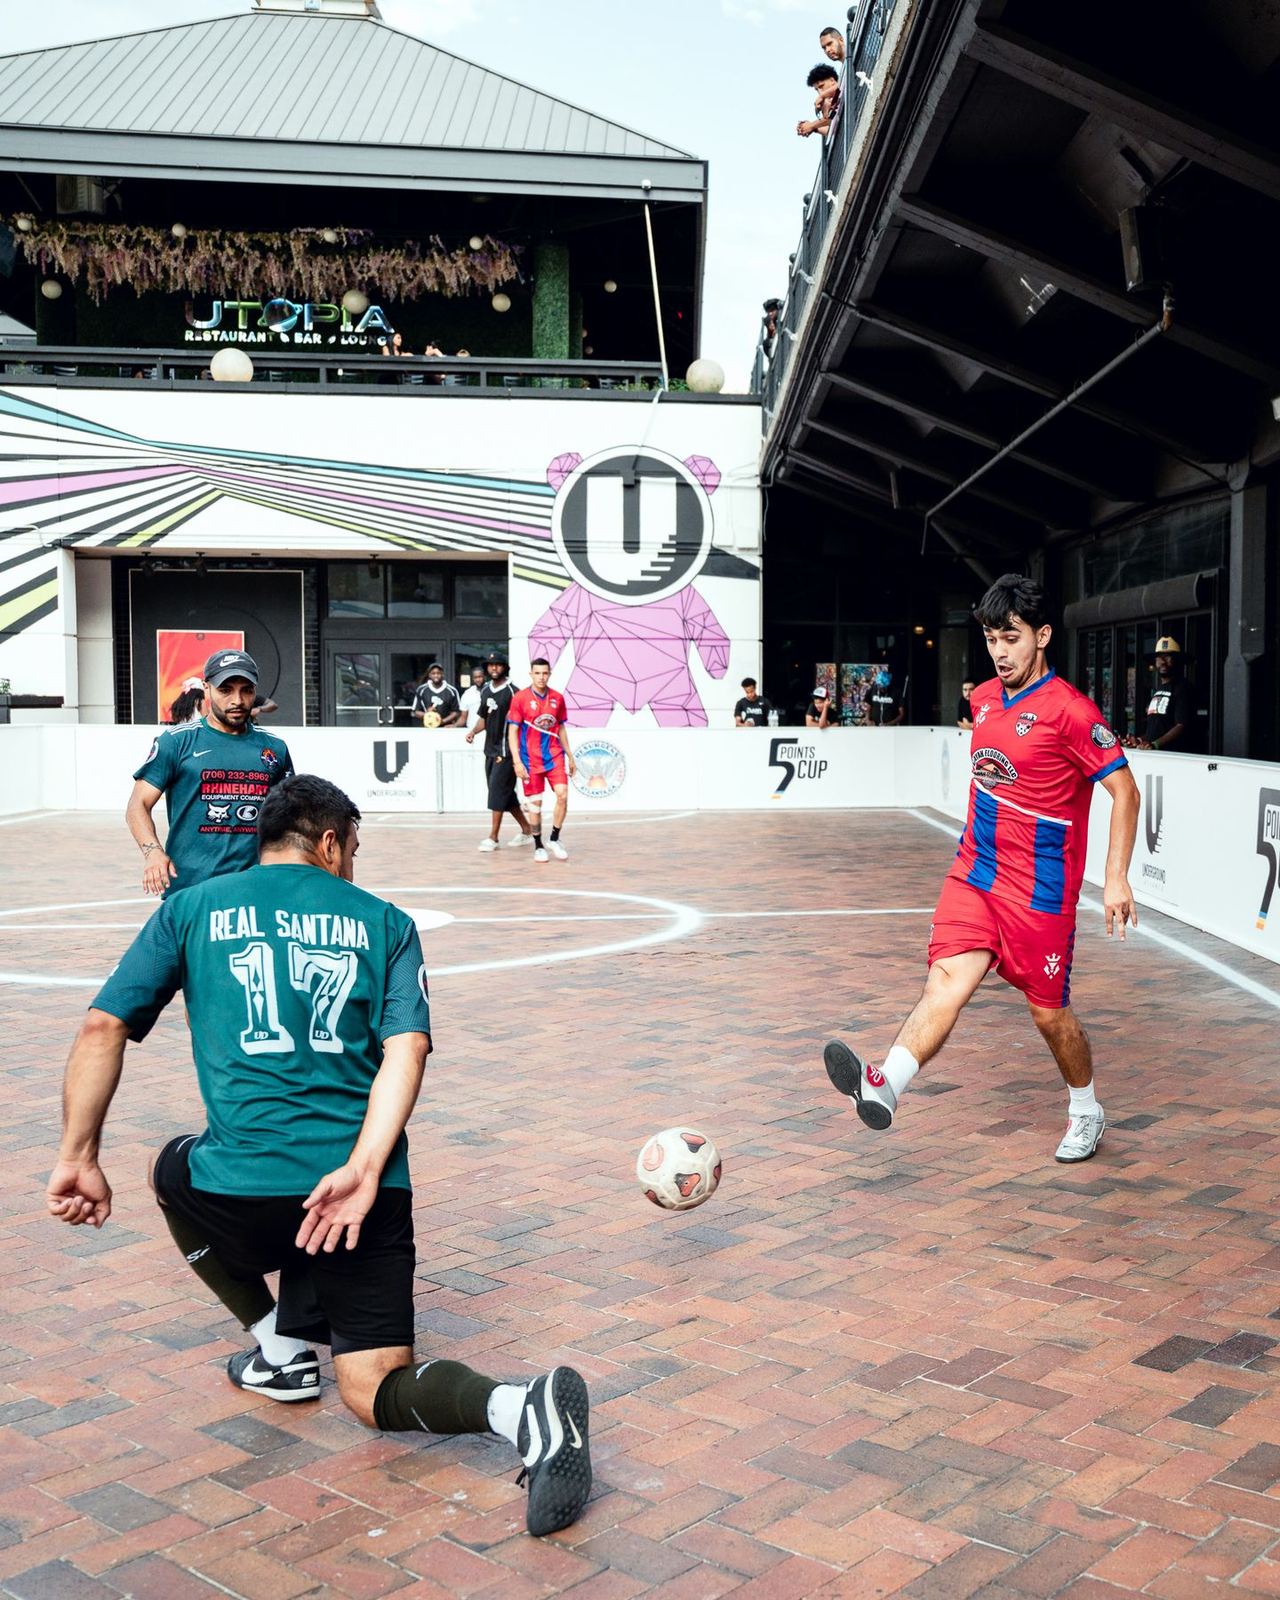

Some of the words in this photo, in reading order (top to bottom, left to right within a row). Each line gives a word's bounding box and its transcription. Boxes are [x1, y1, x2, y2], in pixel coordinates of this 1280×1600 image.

[185, 298, 395, 333] UTOPIA
[185, 330, 274, 342] RESTAURANT
[294, 332, 321, 344] BAR
[340, 334, 387, 346] LOUNG
[780, 746, 815, 759] POINTS
[985, 749, 1009, 767] FLOORING
[202, 770, 226, 780] (706)
[227, 771, 270, 781] 232-8962
[769, 738, 798, 799] 5
[797, 760, 828, 779] CUP
[201, 783, 269, 795] RHINEHART
[210, 906, 265, 942] REAL
[275, 909, 369, 950] SANTANA
[229, 941, 359, 1055] 17
